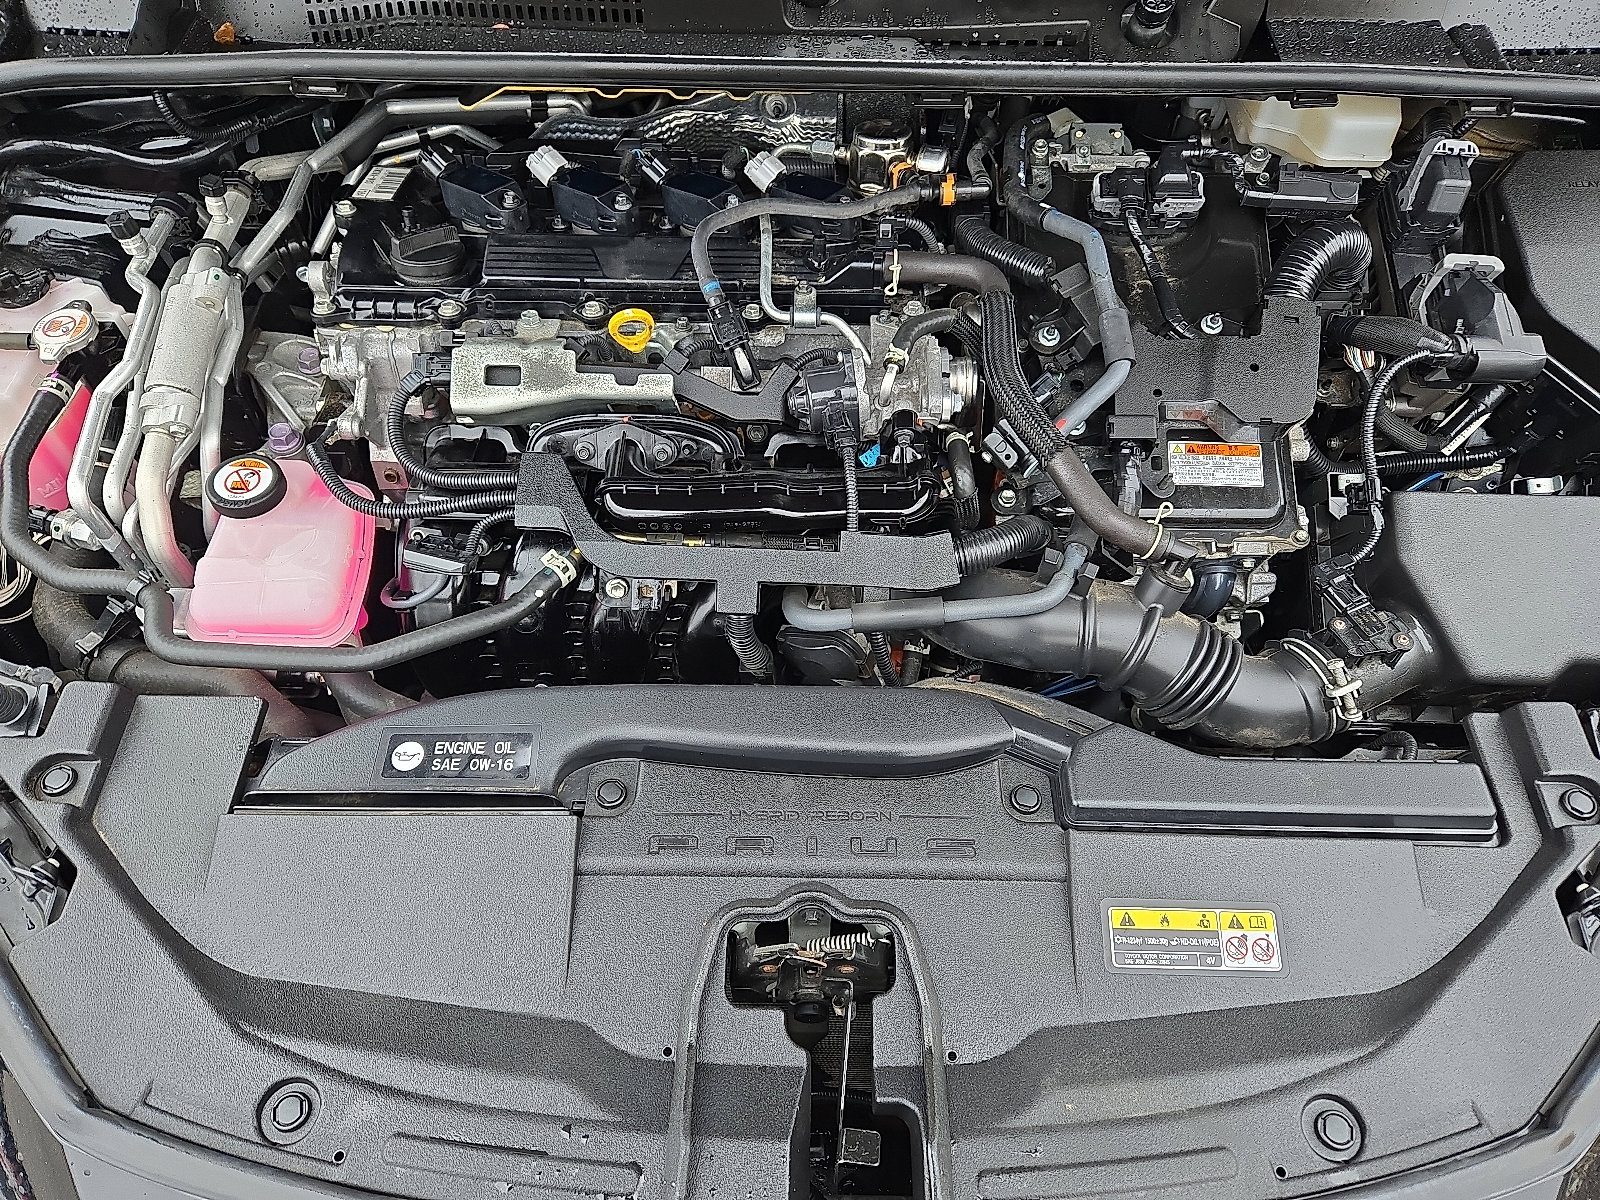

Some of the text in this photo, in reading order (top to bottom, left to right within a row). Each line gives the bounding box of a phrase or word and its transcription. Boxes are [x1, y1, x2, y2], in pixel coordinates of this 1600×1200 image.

[434, 741, 516, 755] ENGINE OIL
[431, 758, 514, 771] SAE 0W-16
[809, 810, 892, 822] REBORN
[649, 834, 977, 859] PRIUS
